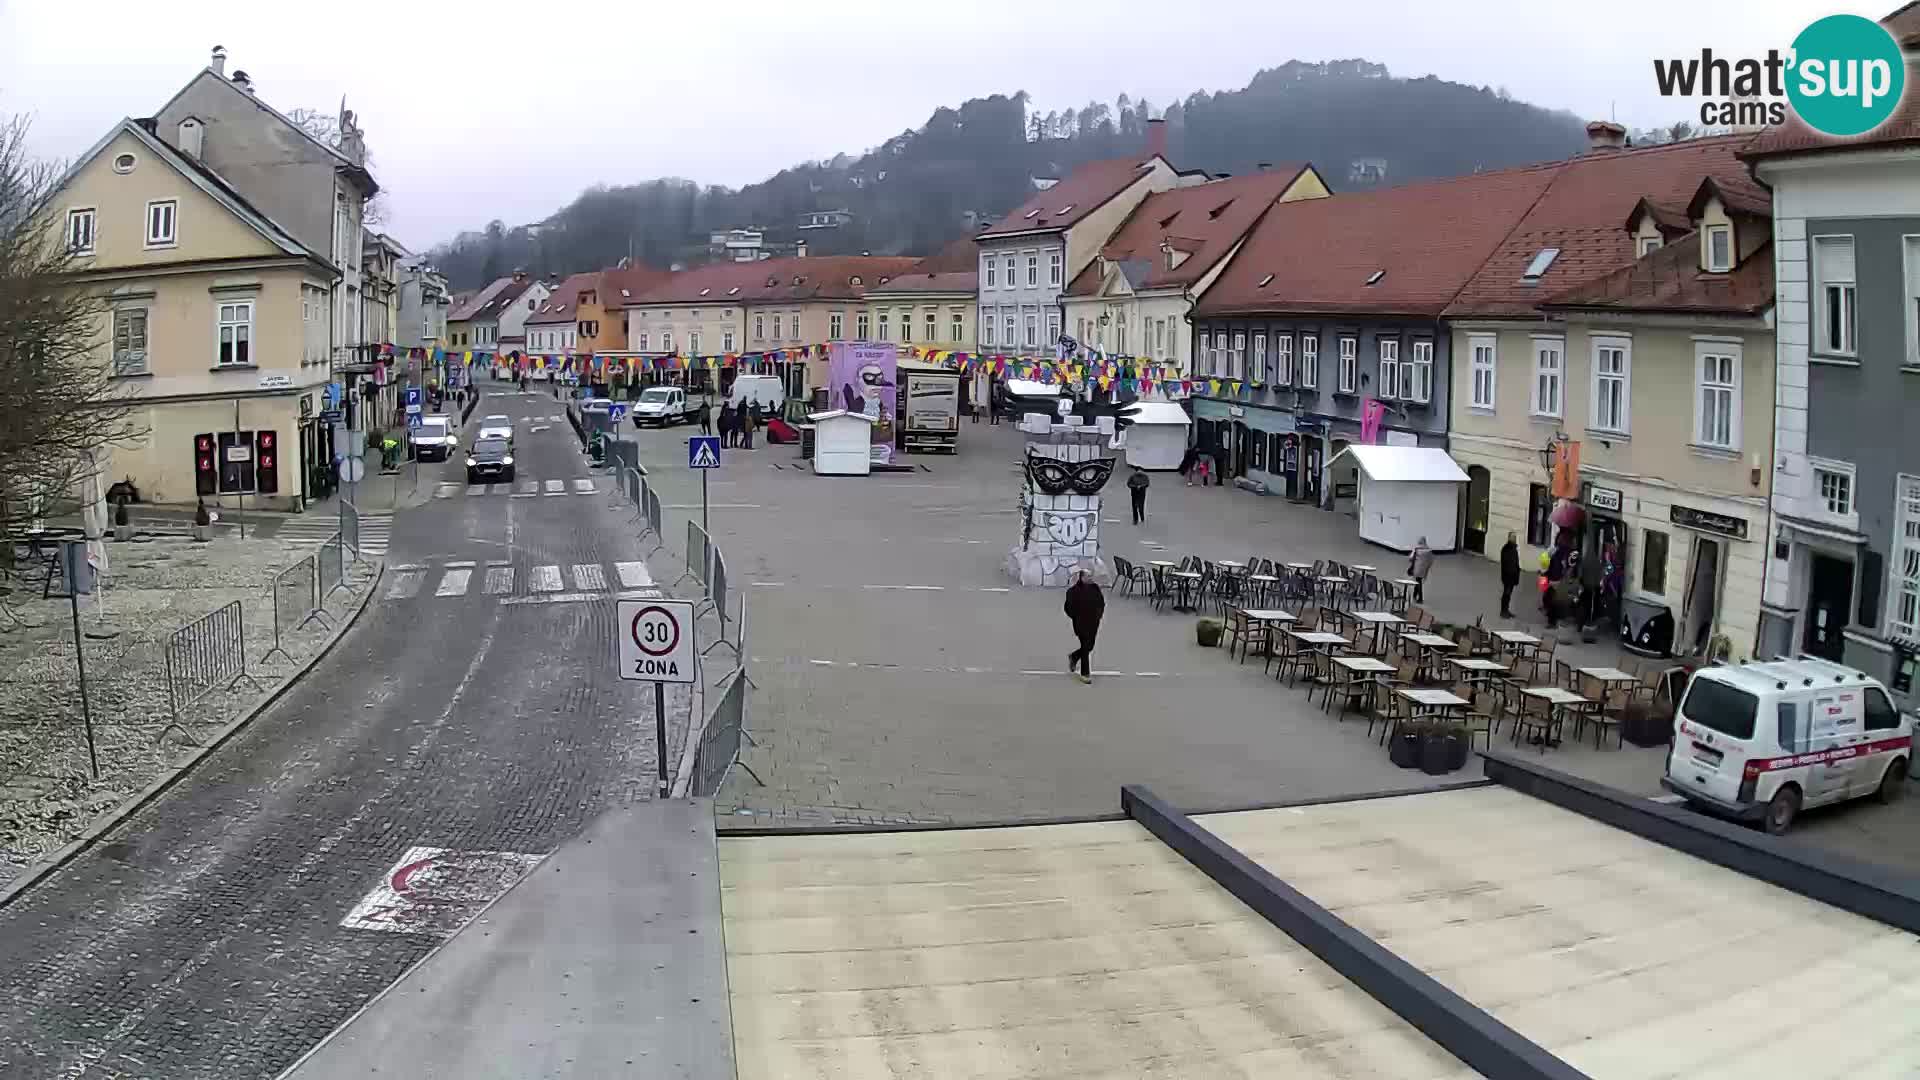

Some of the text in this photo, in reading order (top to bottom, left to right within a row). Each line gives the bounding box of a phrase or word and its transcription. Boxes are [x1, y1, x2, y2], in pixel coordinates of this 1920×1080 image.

[409, 391, 417, 404] P
[1048, 515, 1088, 544] 200
[645, 622, 668, 643] 30
[635, 660, 679, 676] ZONA
